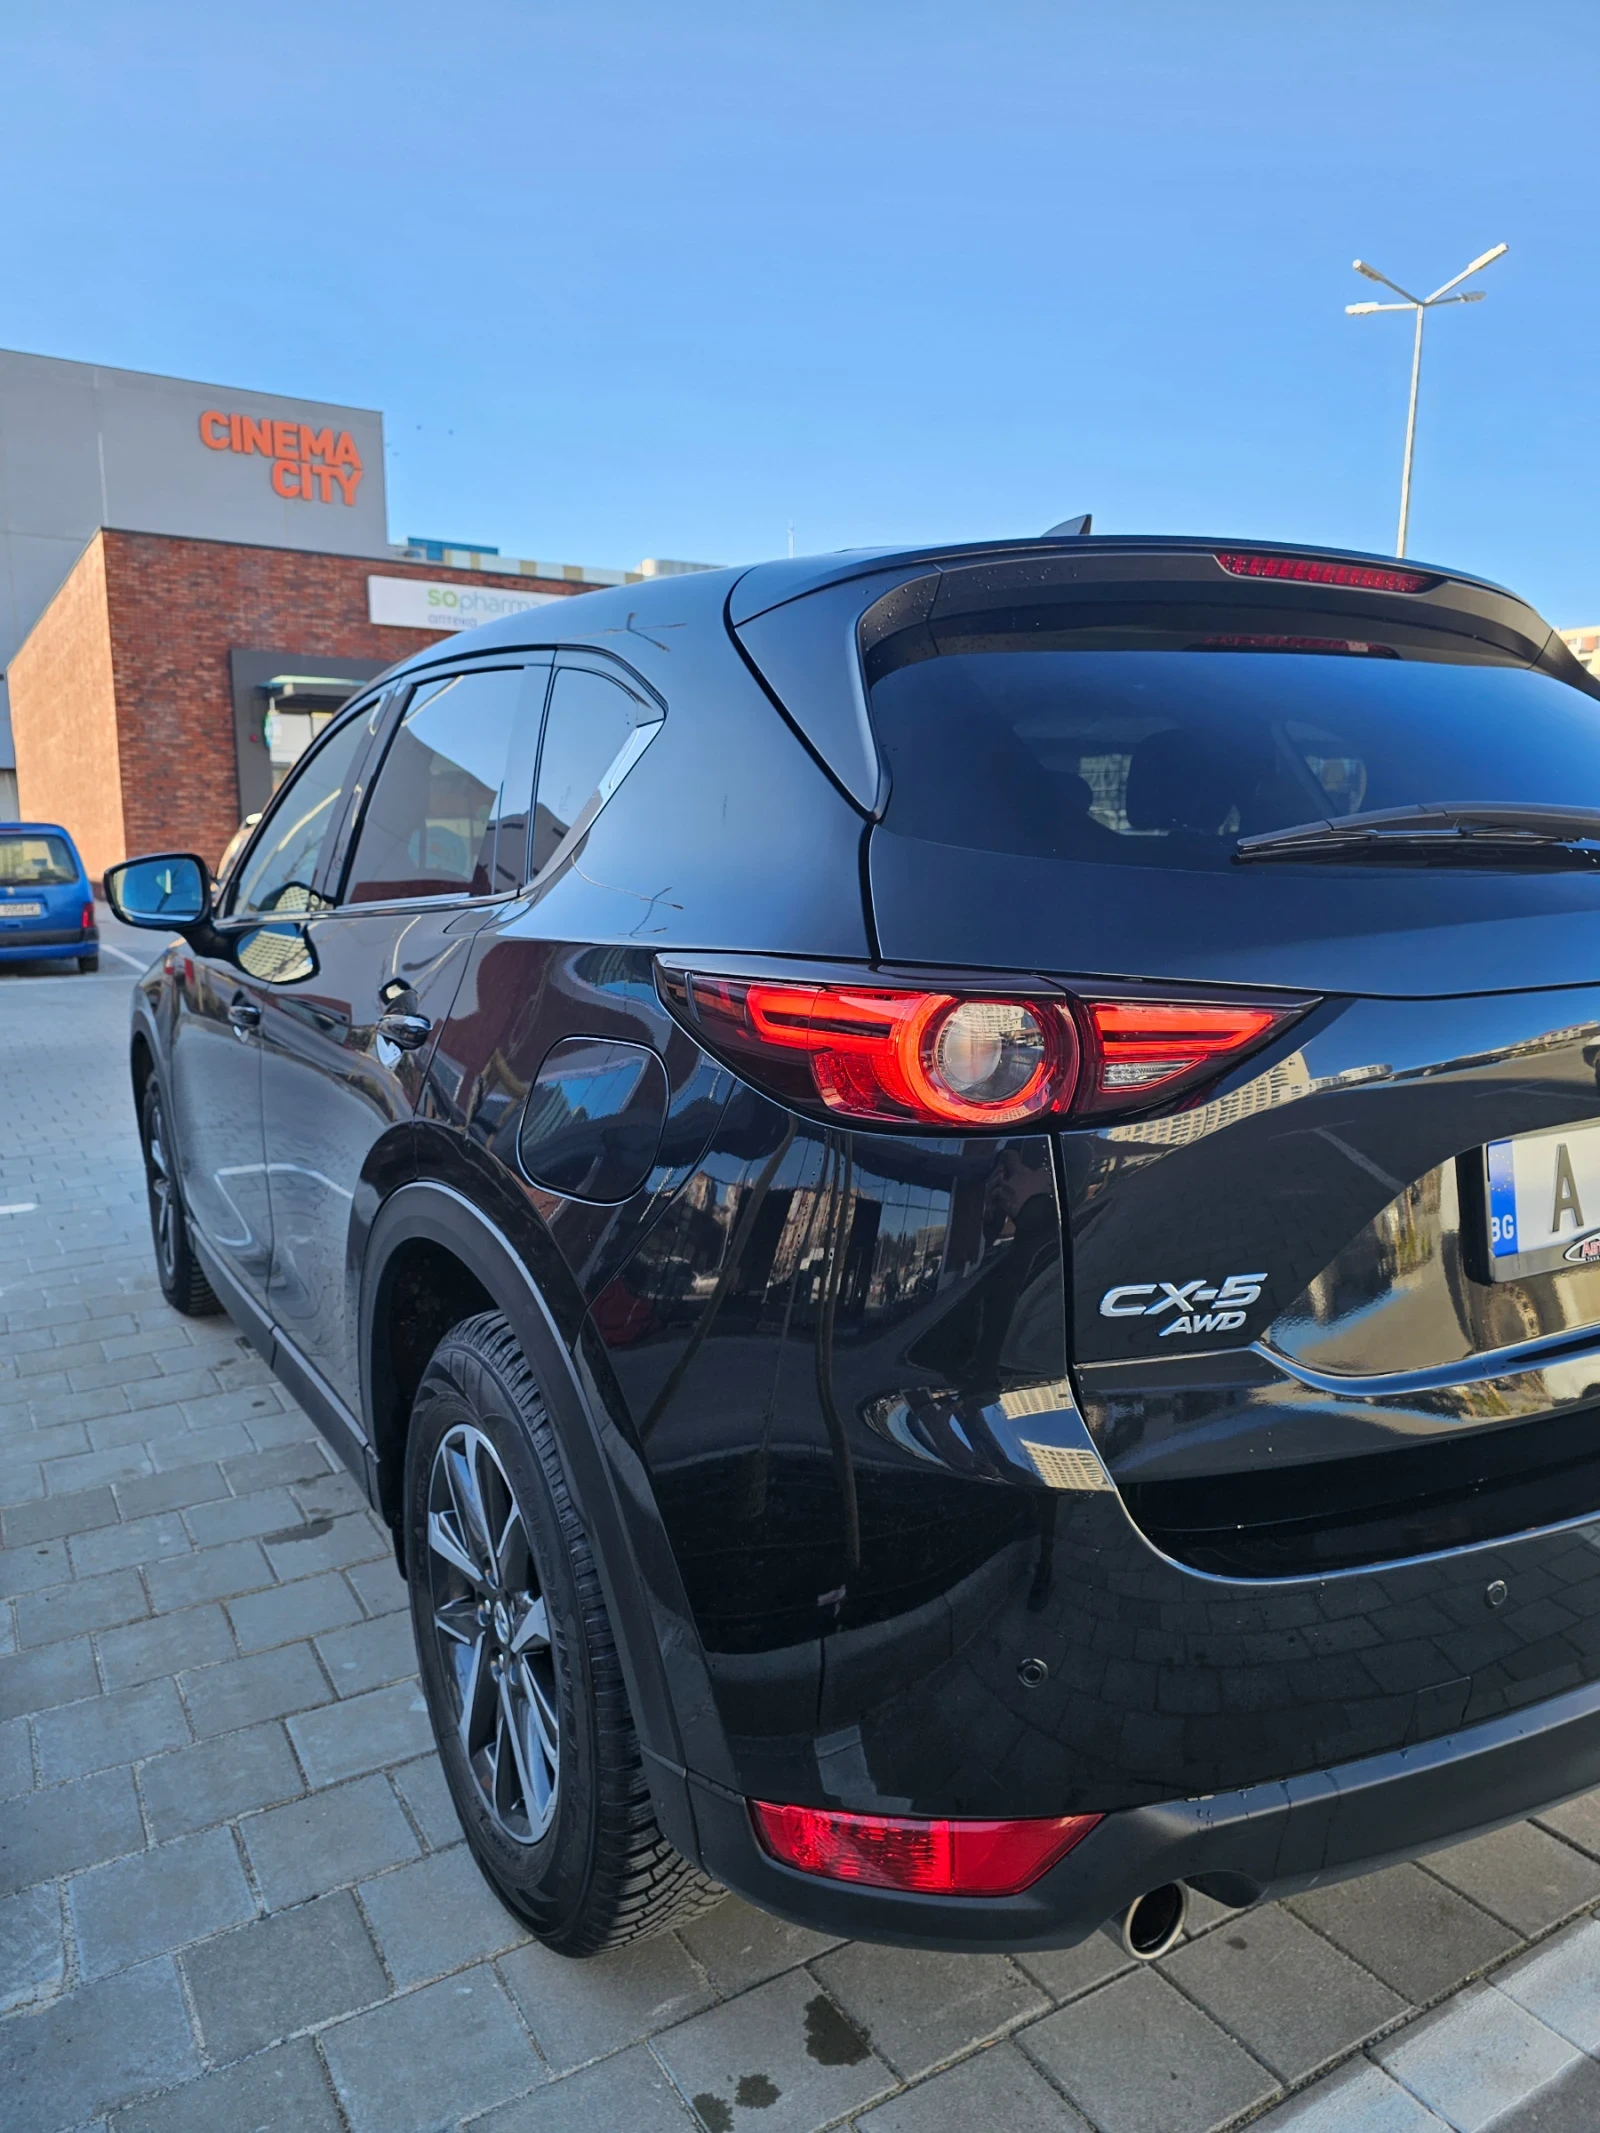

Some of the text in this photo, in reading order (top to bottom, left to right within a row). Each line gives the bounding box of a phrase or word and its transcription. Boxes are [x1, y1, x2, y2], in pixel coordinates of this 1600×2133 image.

[200, 410, 362, 470] CINEMA
[272, 459, 363, 507] CITY
[1552, 1143, 1584, 1233] A
[1491, 1214, 1515, 1243] BG
[1099, 1272, 1268, 1317] CX-5
[1157, 1311, 1247, 1337] AWD
